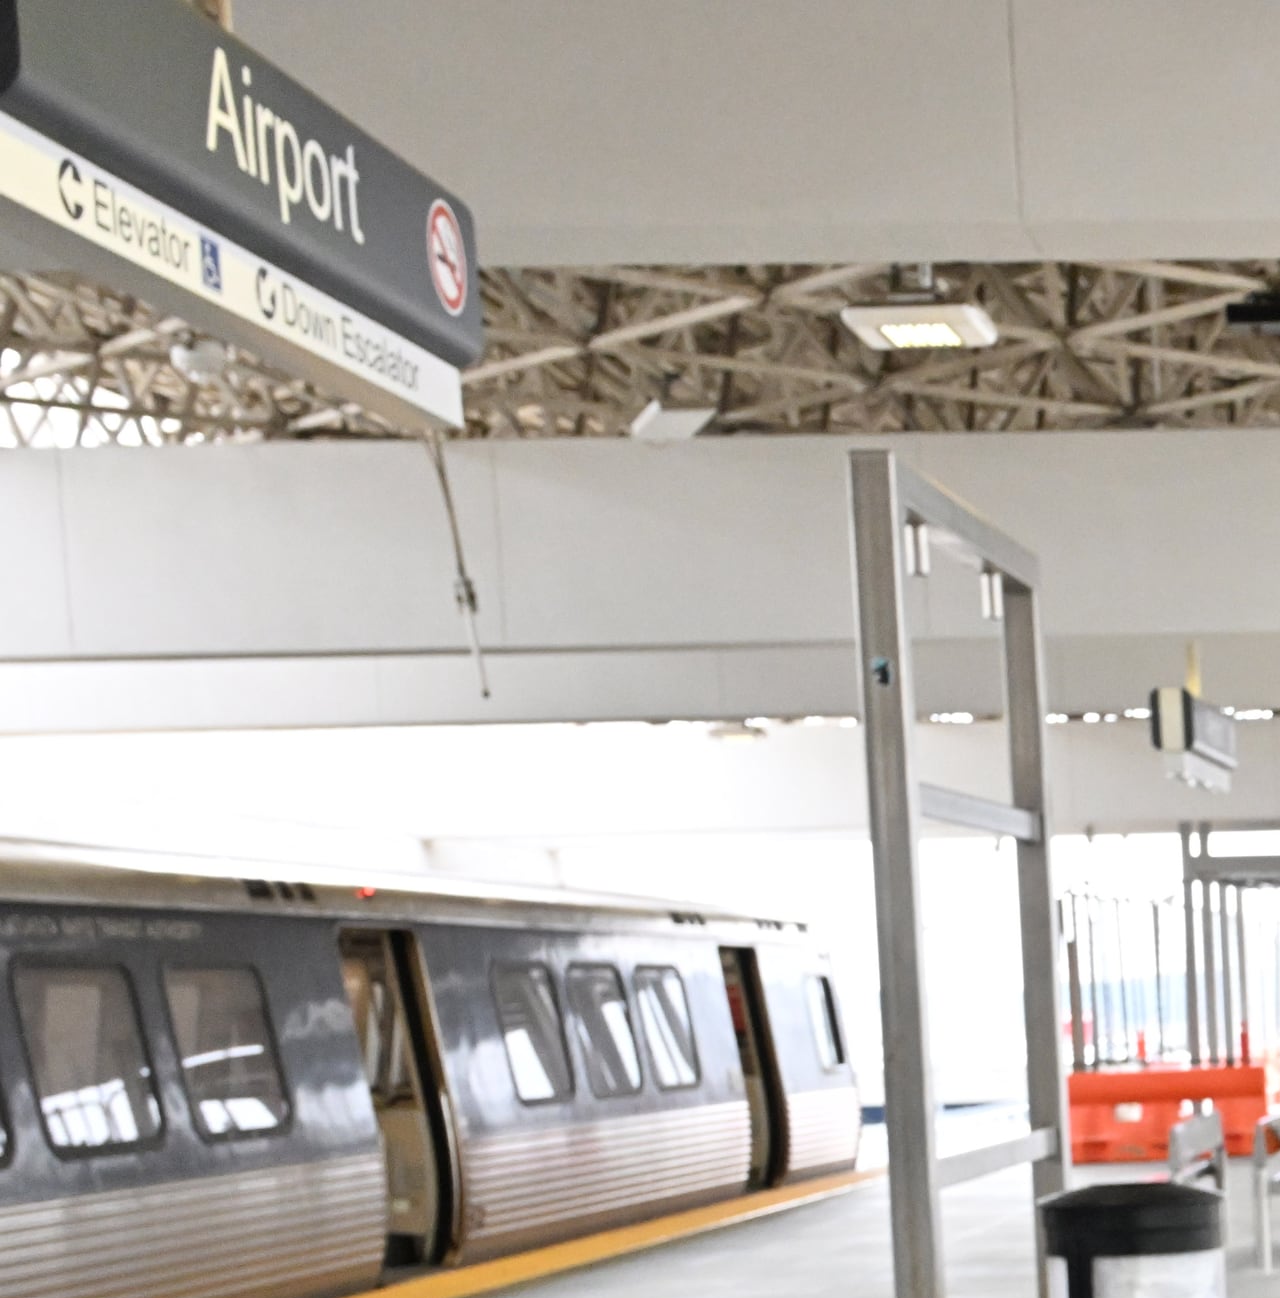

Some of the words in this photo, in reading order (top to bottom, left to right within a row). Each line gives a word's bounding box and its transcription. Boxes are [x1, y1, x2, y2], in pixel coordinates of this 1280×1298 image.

[206, 46, 365, 245] Airport
[94, 180, 191, 273] Elevator
[281, 284, 338, 350] Down
[341, 320, 420, 392] Escalator
